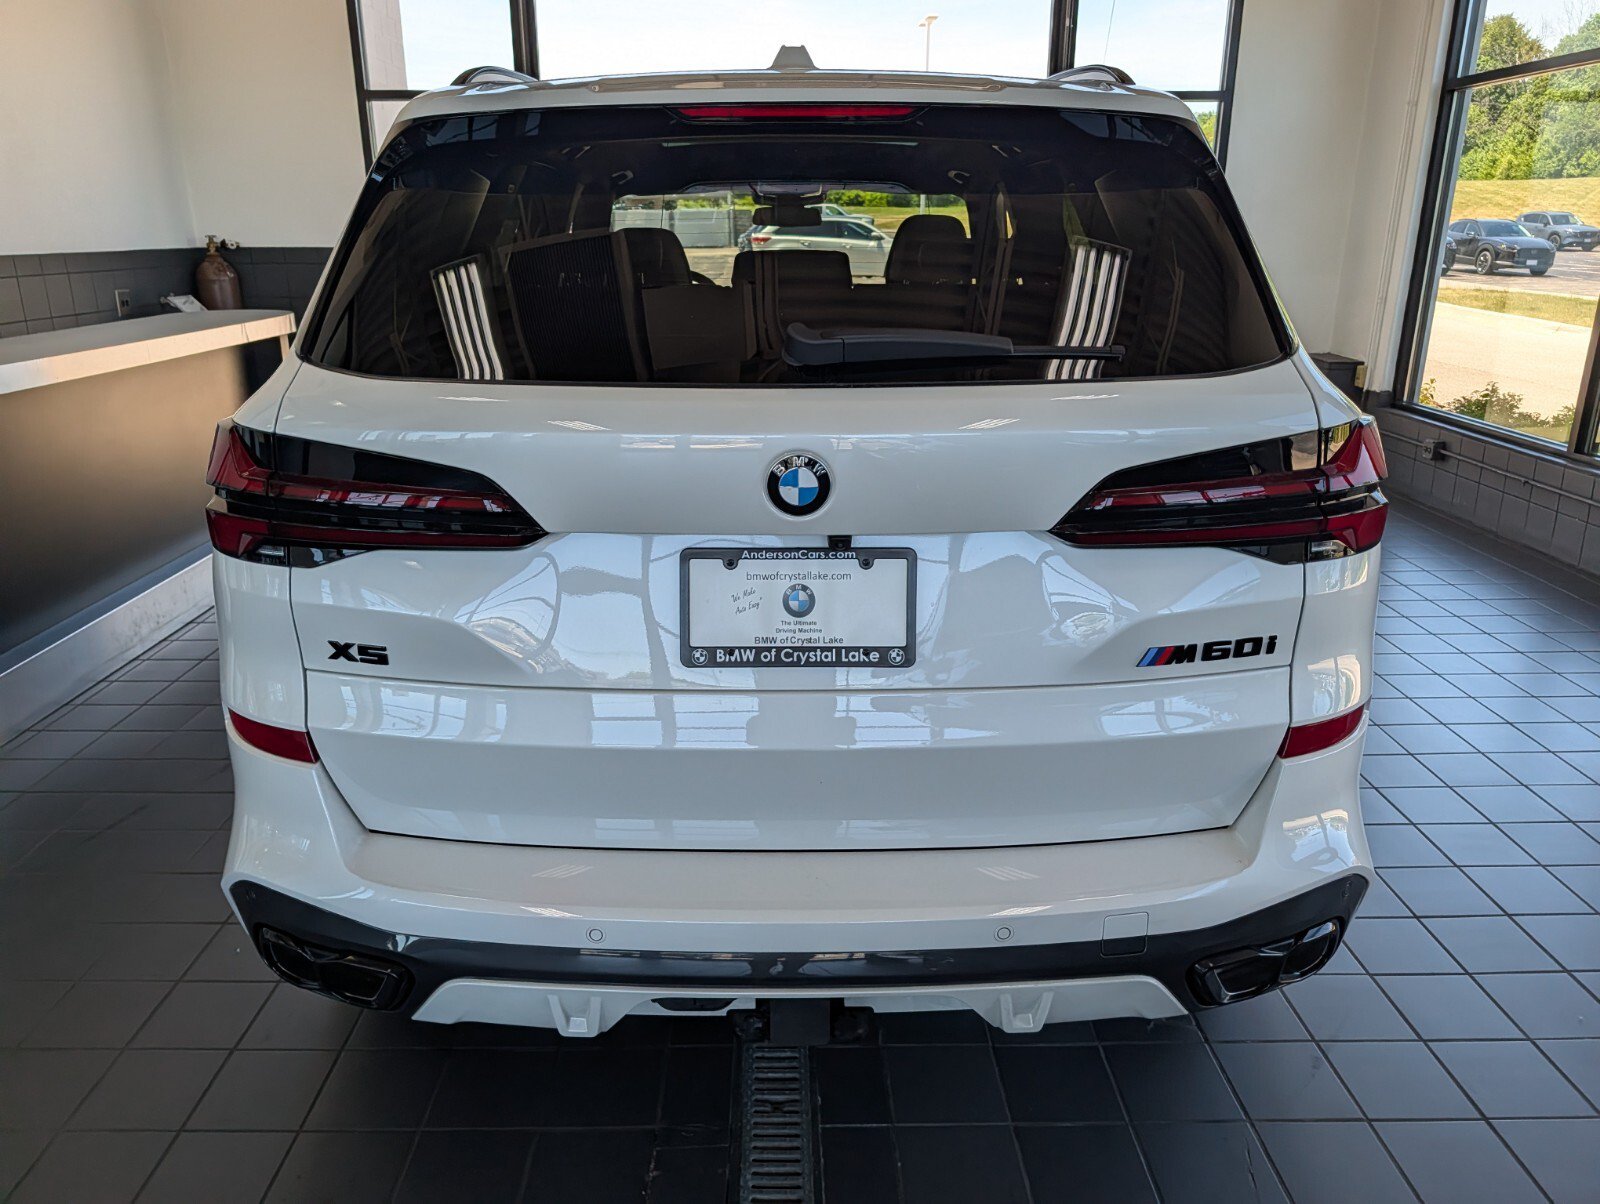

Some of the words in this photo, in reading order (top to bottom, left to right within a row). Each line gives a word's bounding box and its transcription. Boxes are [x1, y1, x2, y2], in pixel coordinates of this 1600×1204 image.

[772, 456, 827, 477] BMW
[741, 549, 856, 560] AndersonCars.com
[746, 571, 852, 583] bmwofcrystallake.com
[775, 627, 797, 635] Driving
[754, 636, 778, 645] BMW
[780, 636, 790, 645] of
[790, 636, 820, 646] Crystal
[822, 636, 844, 645] Lake
[327, 640, 389, 666] X5
[716, 648, 756, 663] BMW
[760, 648, 777, 663] of
[780, 648, 836, 665] Crystal
[841, 648, 880, 662] Lake
